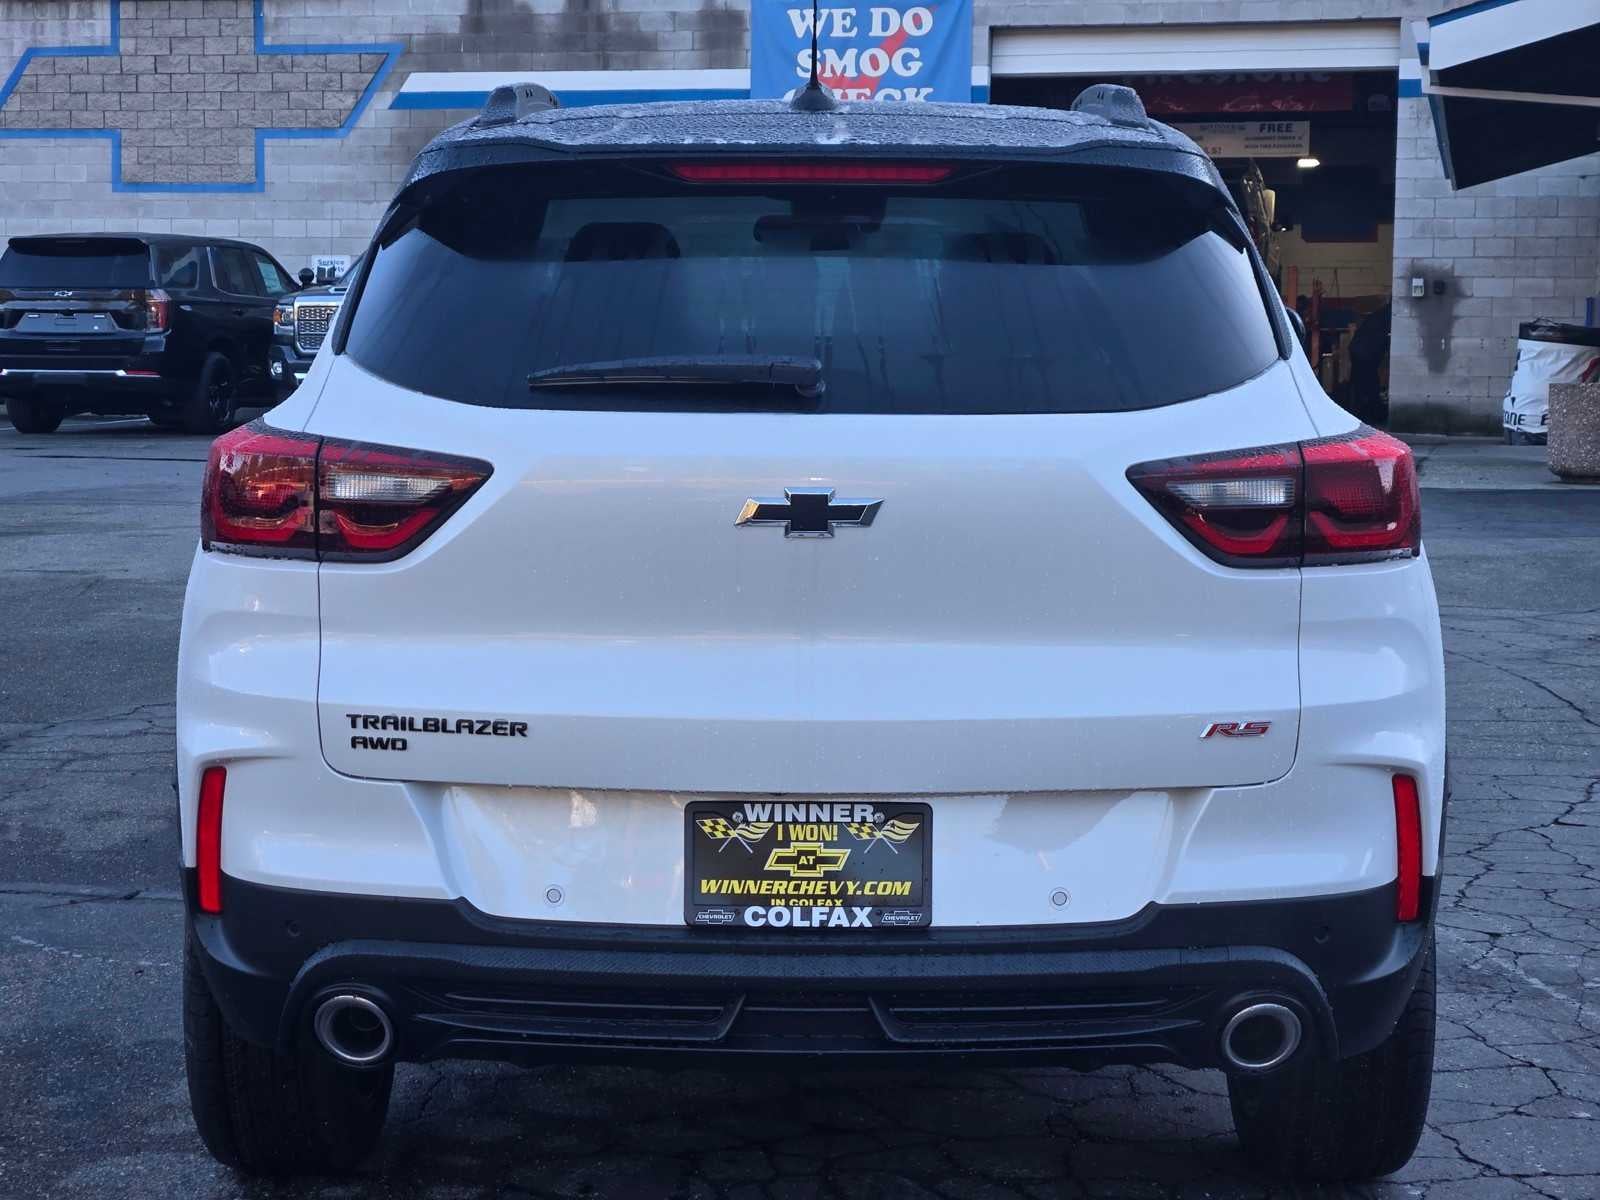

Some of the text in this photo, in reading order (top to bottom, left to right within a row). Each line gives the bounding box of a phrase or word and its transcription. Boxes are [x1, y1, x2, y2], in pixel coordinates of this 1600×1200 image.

[787, 7, 933, 38] WE DO
[796, 48, 923, 78] SMOG
[1259, 123, 1294, 134] FREE
[346, 713, 528, 737] TRAILBLAZER
[1200, 721, 1272, 738] RS
[351, 735, 408, 751] AWD
[744, 803, 874, 822] WINNER
[777, 825, 838, 841] I WON!
[799, 856, 815, 865] AT
[701, 879, 911, 896] WINNERCHEVY.COM
[770, 898, 843, 906] IN COLFAX
[744, 906, 872, 928] COLFAX
